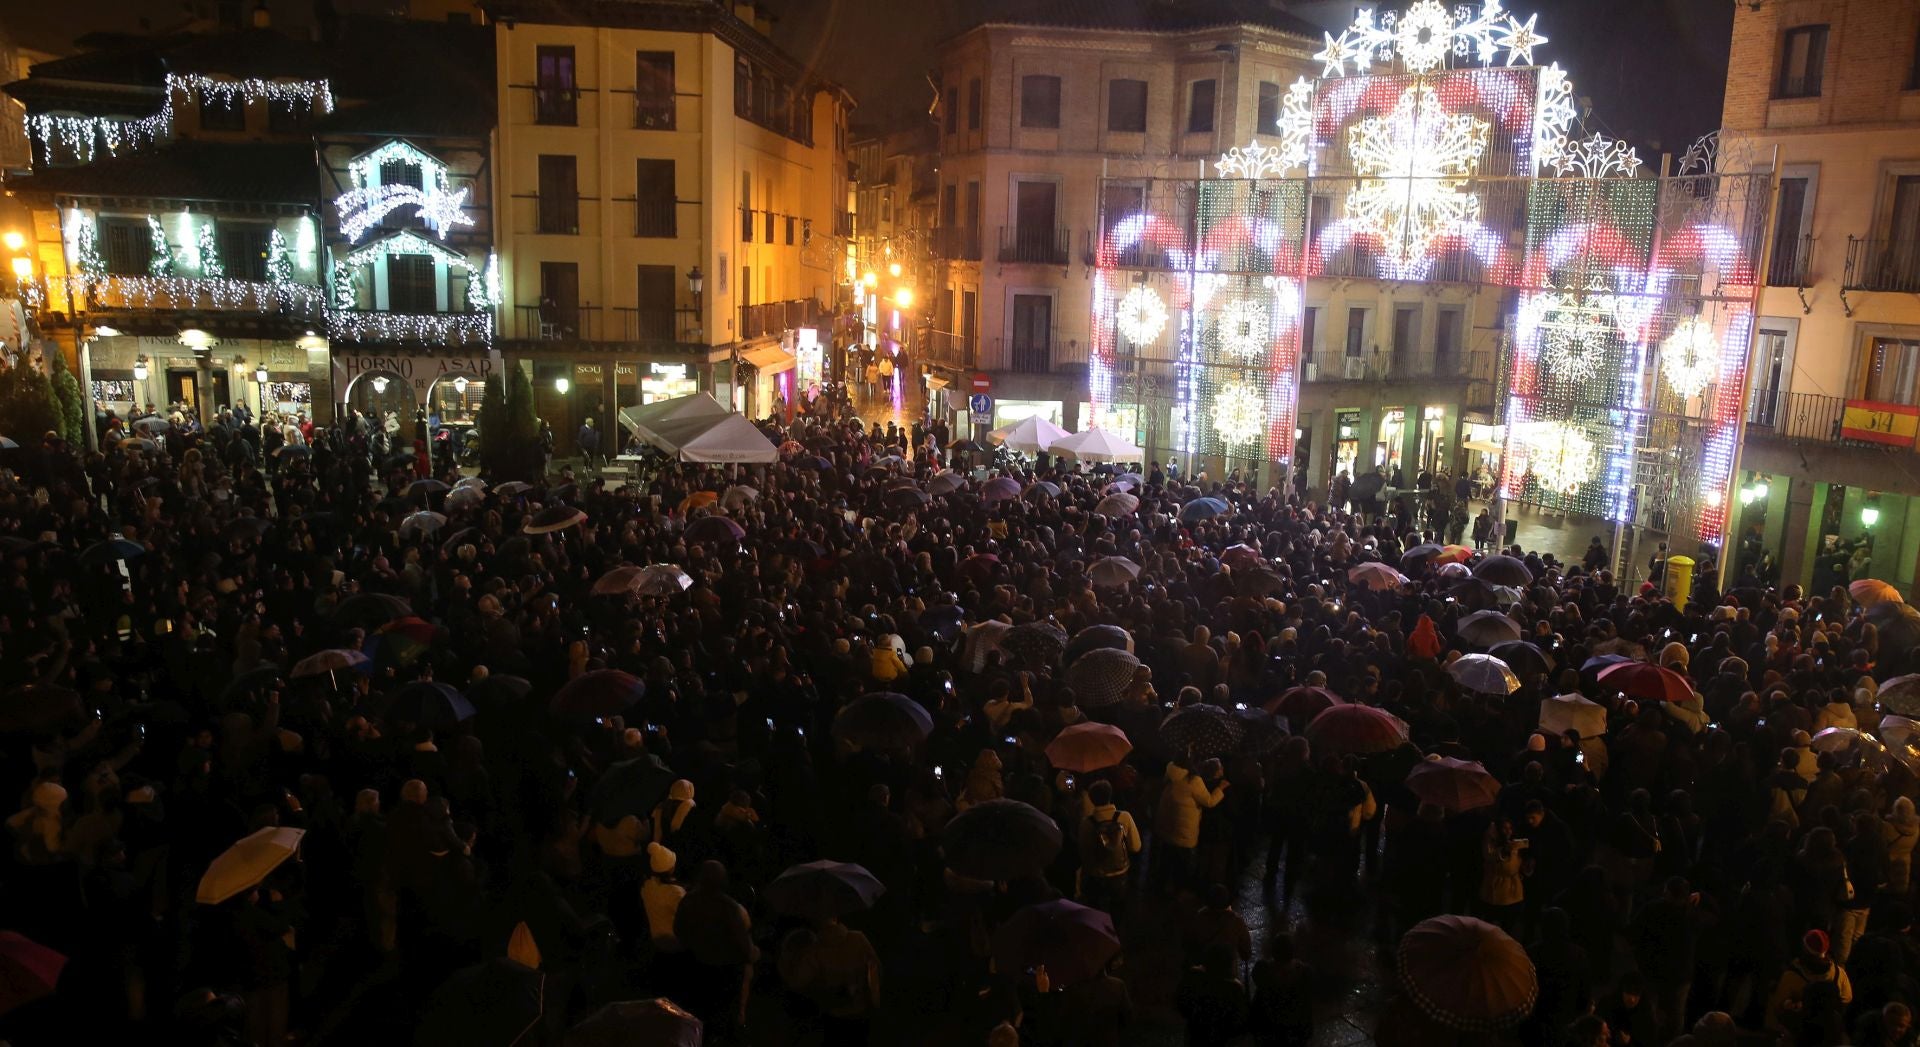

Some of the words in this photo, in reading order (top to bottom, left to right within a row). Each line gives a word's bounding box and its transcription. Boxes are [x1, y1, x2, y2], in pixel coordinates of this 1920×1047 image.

[346, 356, 413, 383] HORNO
[416, 378, 426, 389] DE
[437, 358, 492, 379] ASAR
[577, 365, 633, 375] SOUNIR
